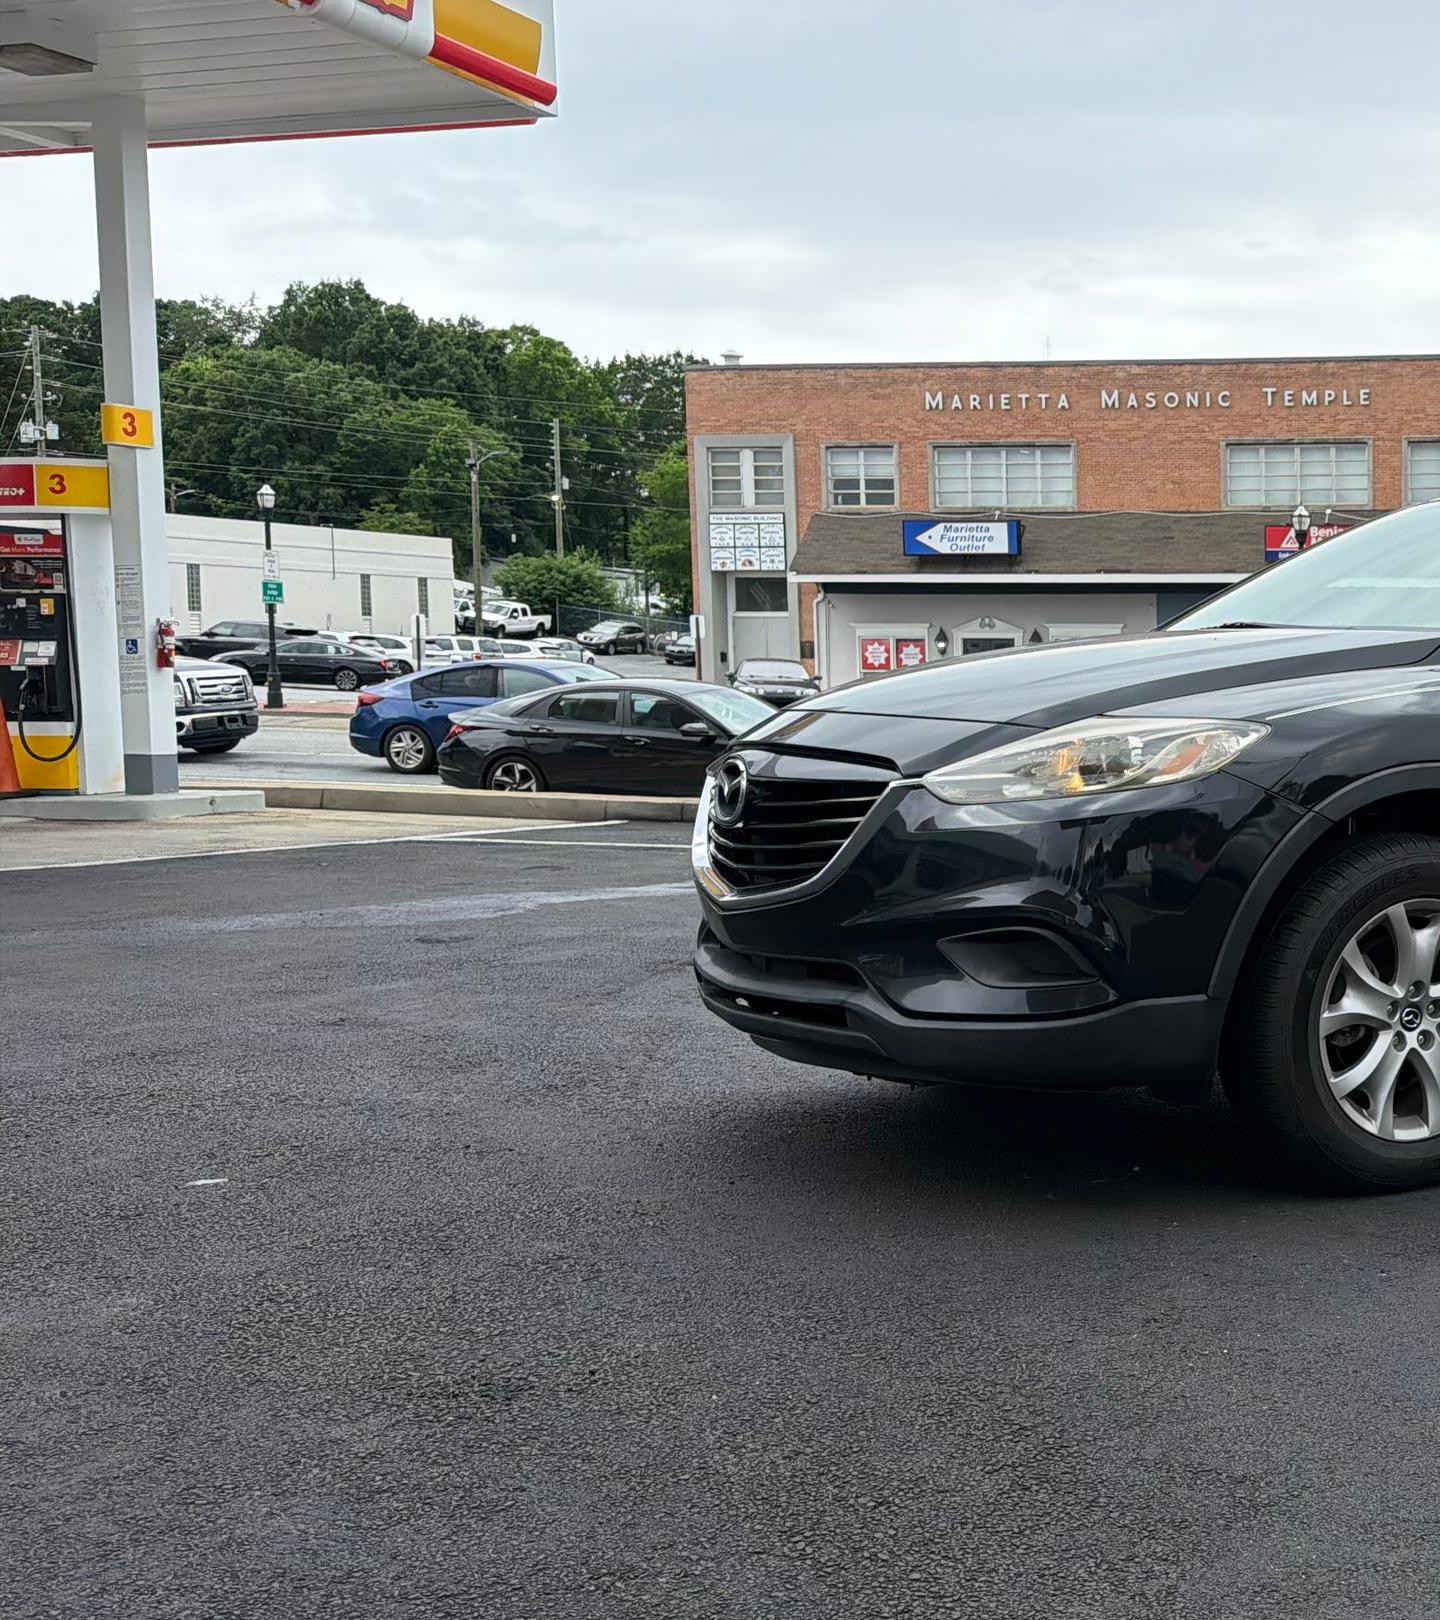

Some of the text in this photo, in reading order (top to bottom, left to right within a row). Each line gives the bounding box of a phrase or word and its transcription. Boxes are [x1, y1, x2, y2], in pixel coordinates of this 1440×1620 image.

[924, 387, 1371, 411] MARIETTA MASONIC TEMPLE
[122, 411, 137, 437] 3
[48, 473, 66, 495] 3
[942, 524, 990, 533] Marietta
[940, 533, 994, 543] Furniture
[949, 543, 986, 552] Outlet
